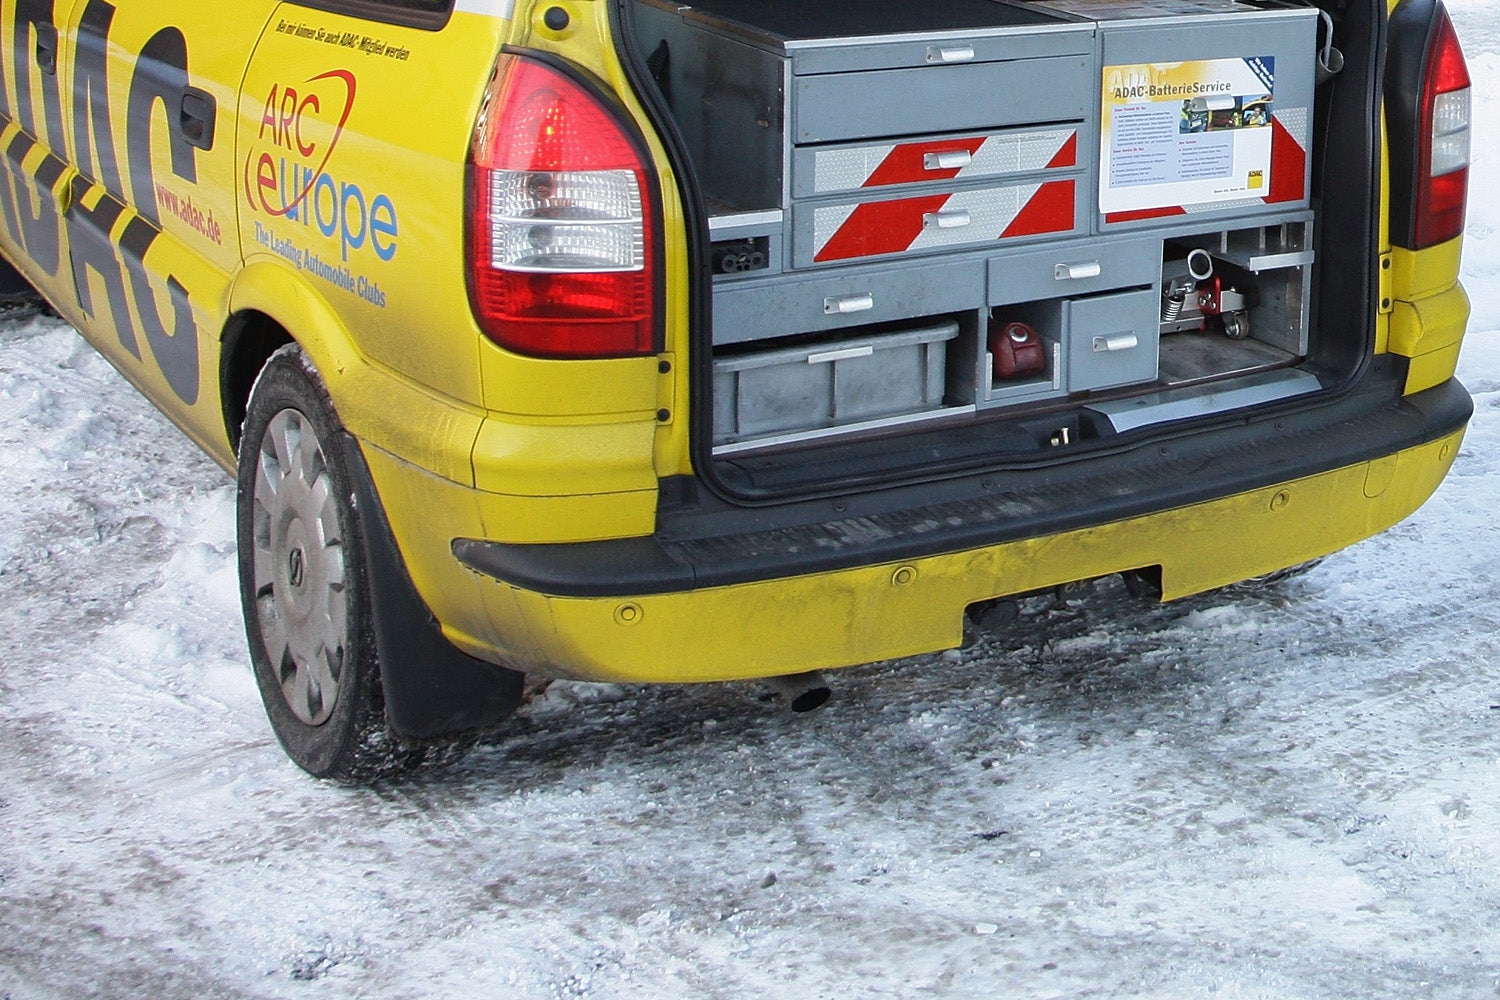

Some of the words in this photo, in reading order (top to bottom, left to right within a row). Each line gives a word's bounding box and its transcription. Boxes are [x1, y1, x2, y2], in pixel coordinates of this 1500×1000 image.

[314, 27, 326, 41] Sie
[324, 31, 341, 45] auch
[384, 45, 410, 61] werden
[258, 82, 320, 157] ARC
[1114, 81, 1232, 99] ADAC-BatterieService
[155, 182, 221, 246] www.adac.de
[256, 152, 398, 262] europe
[254, 221, 270, 249] The
[270, 230, 303, 269] Leading
[303, 248, 356, 294] Automobile
[356, 276, 386, 307] Clubs
